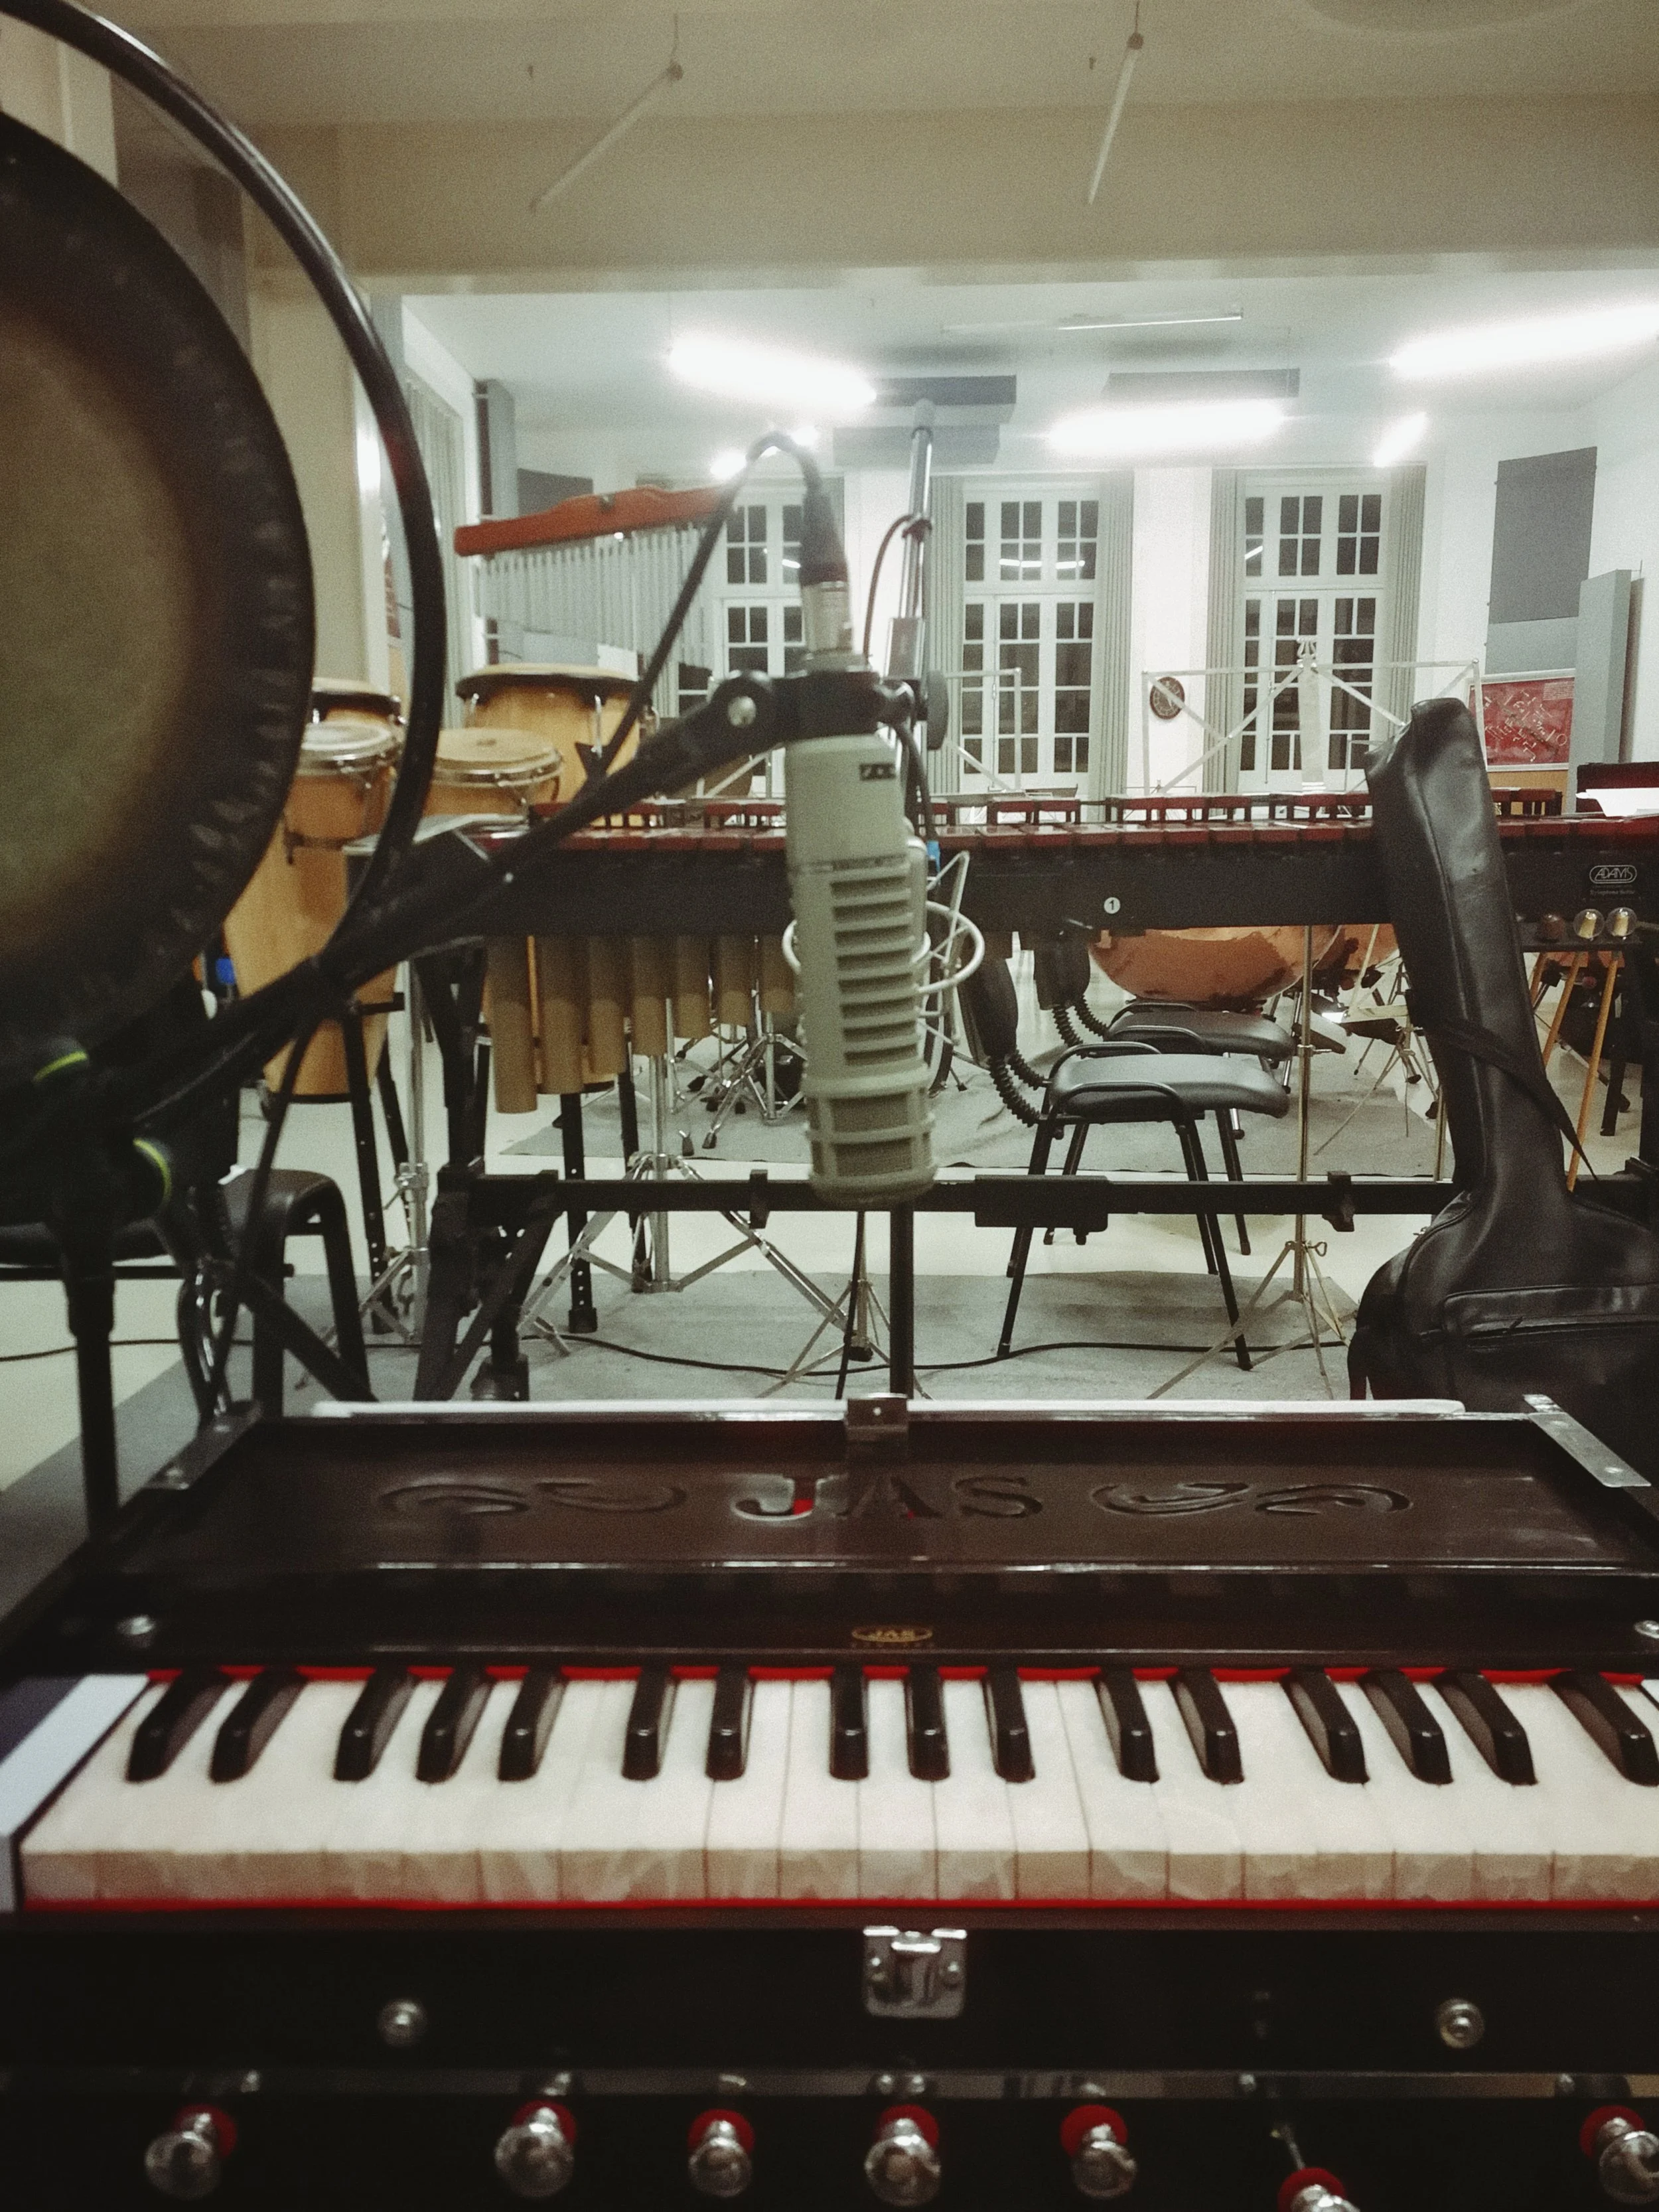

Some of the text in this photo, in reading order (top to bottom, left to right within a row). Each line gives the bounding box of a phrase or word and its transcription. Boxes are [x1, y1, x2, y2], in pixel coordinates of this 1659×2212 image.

[1595, 867, 1633, 881] ADAMS
[1109, 899, 1115, 910] 1
[731, 1473, 1043, 1521] JAS
